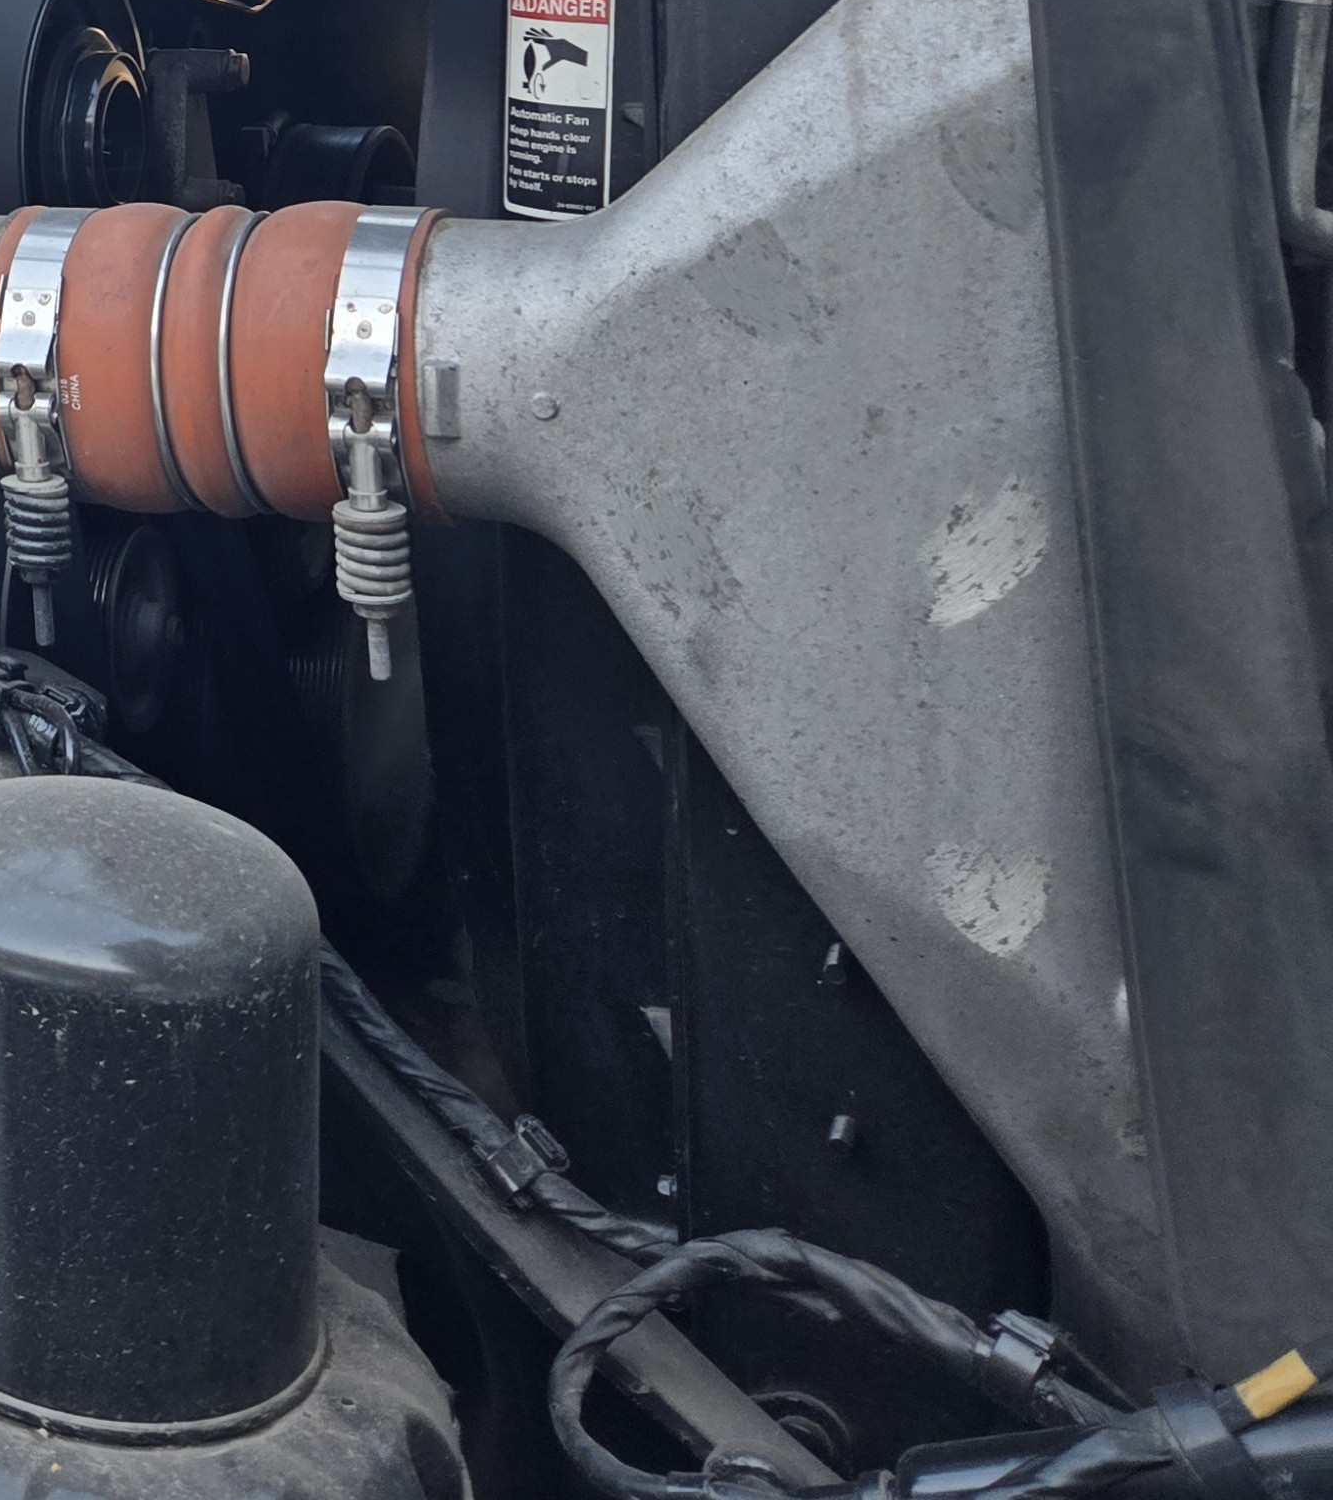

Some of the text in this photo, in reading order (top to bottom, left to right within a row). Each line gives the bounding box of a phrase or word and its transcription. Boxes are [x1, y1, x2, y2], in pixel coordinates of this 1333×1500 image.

[510, 106, 590, 126] Automatic Fan
[510, 124, 591, 143] Keep hands clear
[509, 138, 577, 154] when engine is
[509, 150, 542, 165] running.
[508, 177, 543, 192] by itself.
[509, 164, 597, 187] Fan starts or stops
[69, 374, 81, 411] CHINA
